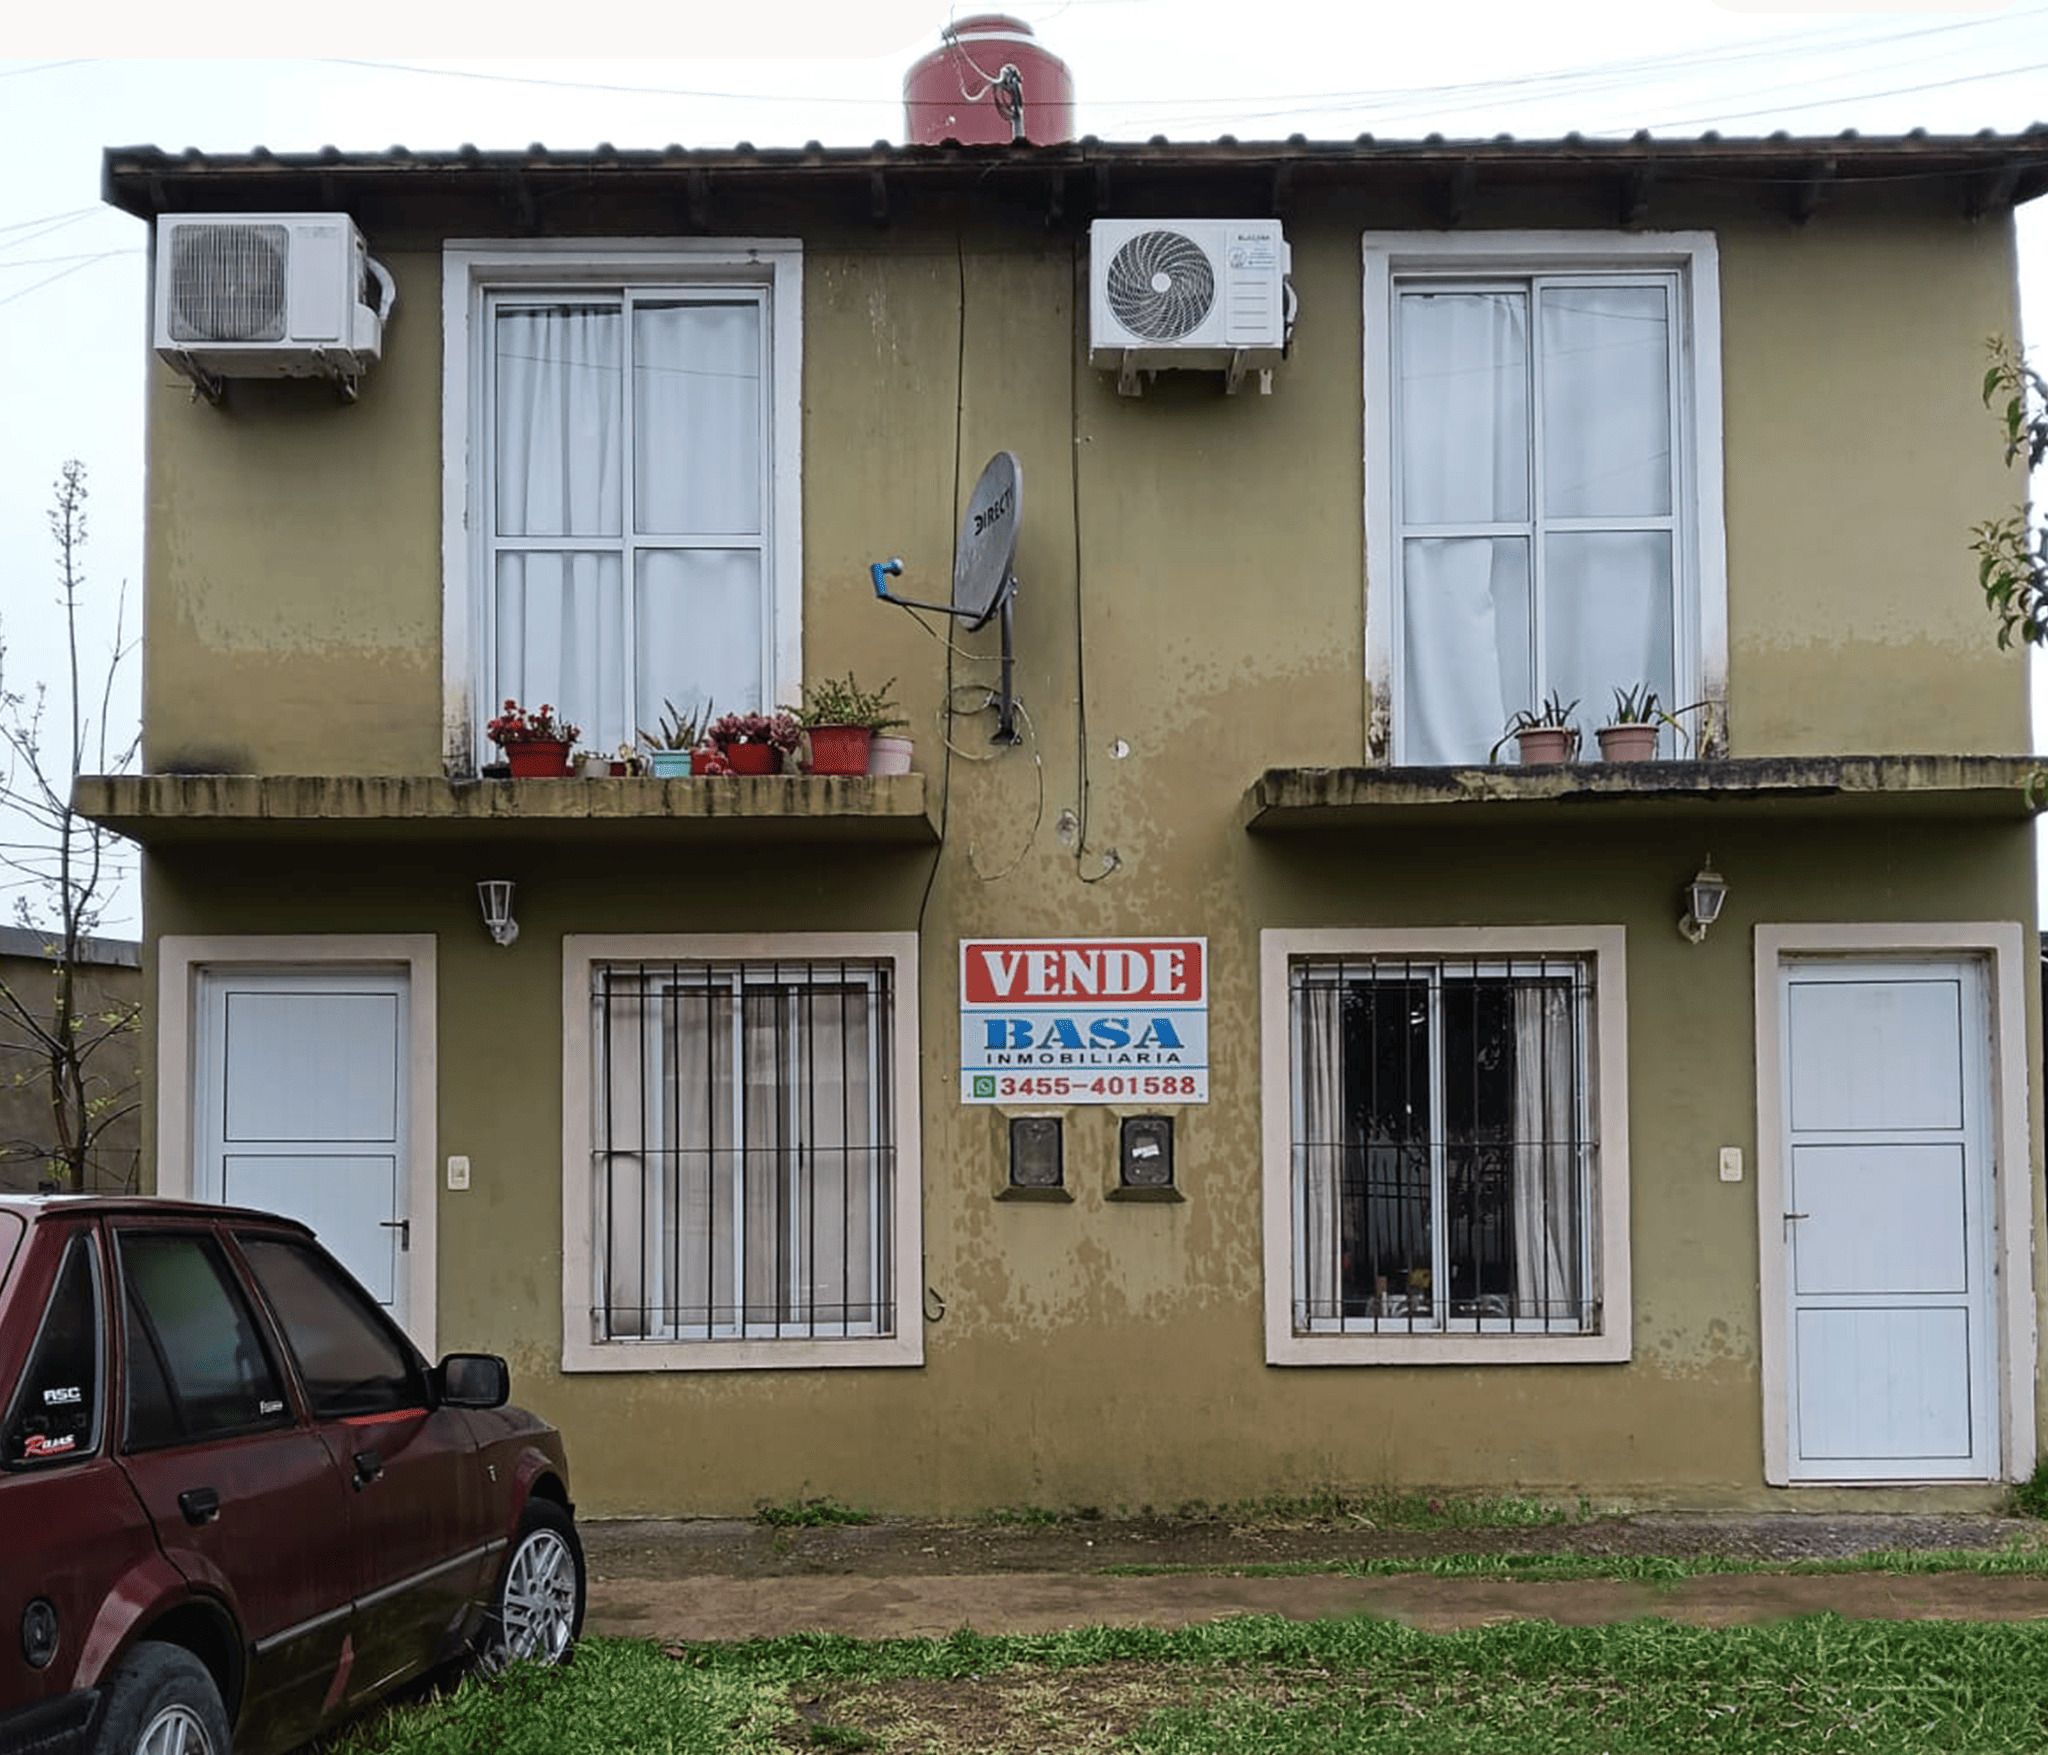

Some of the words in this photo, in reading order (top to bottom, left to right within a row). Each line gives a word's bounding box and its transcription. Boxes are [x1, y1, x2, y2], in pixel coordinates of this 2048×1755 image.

[981, 948, 1186, 997] VENDE
[984, 1018, 1185, 1050] BASA
[987, 1052, 1182, 1064] INMOBILIARIA
[1000, 1075, 1196, 1096] 3455-401588
